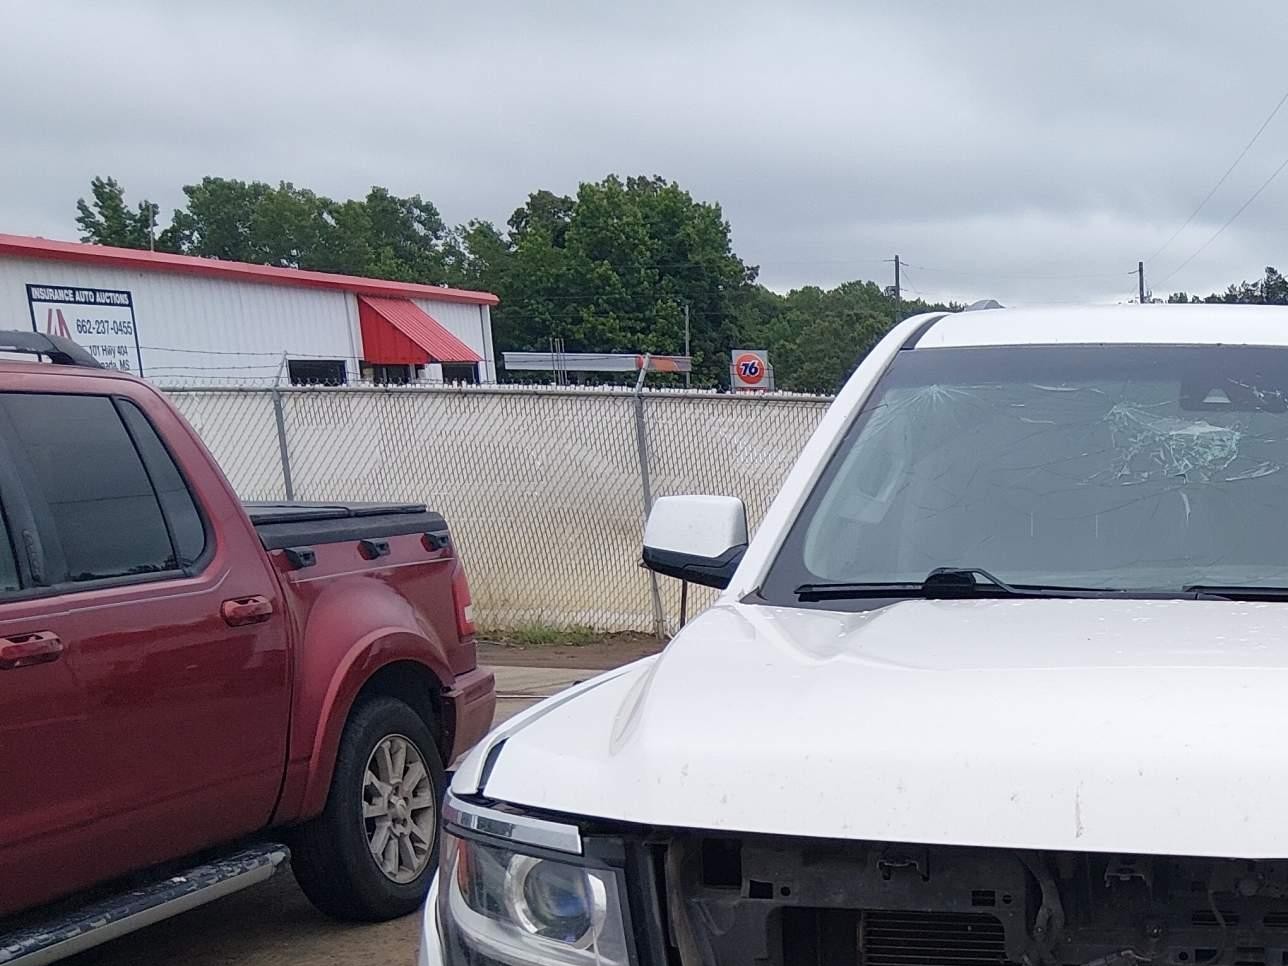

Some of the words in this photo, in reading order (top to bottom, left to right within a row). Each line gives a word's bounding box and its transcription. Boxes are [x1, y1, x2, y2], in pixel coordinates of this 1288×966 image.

[30, 287, 75, 301] INSURANCE
[75, 290, 95, 303] AUTO
[96, 292, 130, 305] AUCTIONS
[76, 319, 133, 335] 662-237-0455
[101, 345, 116, 358] Hwy
[740, 360, 760, 377] 76
